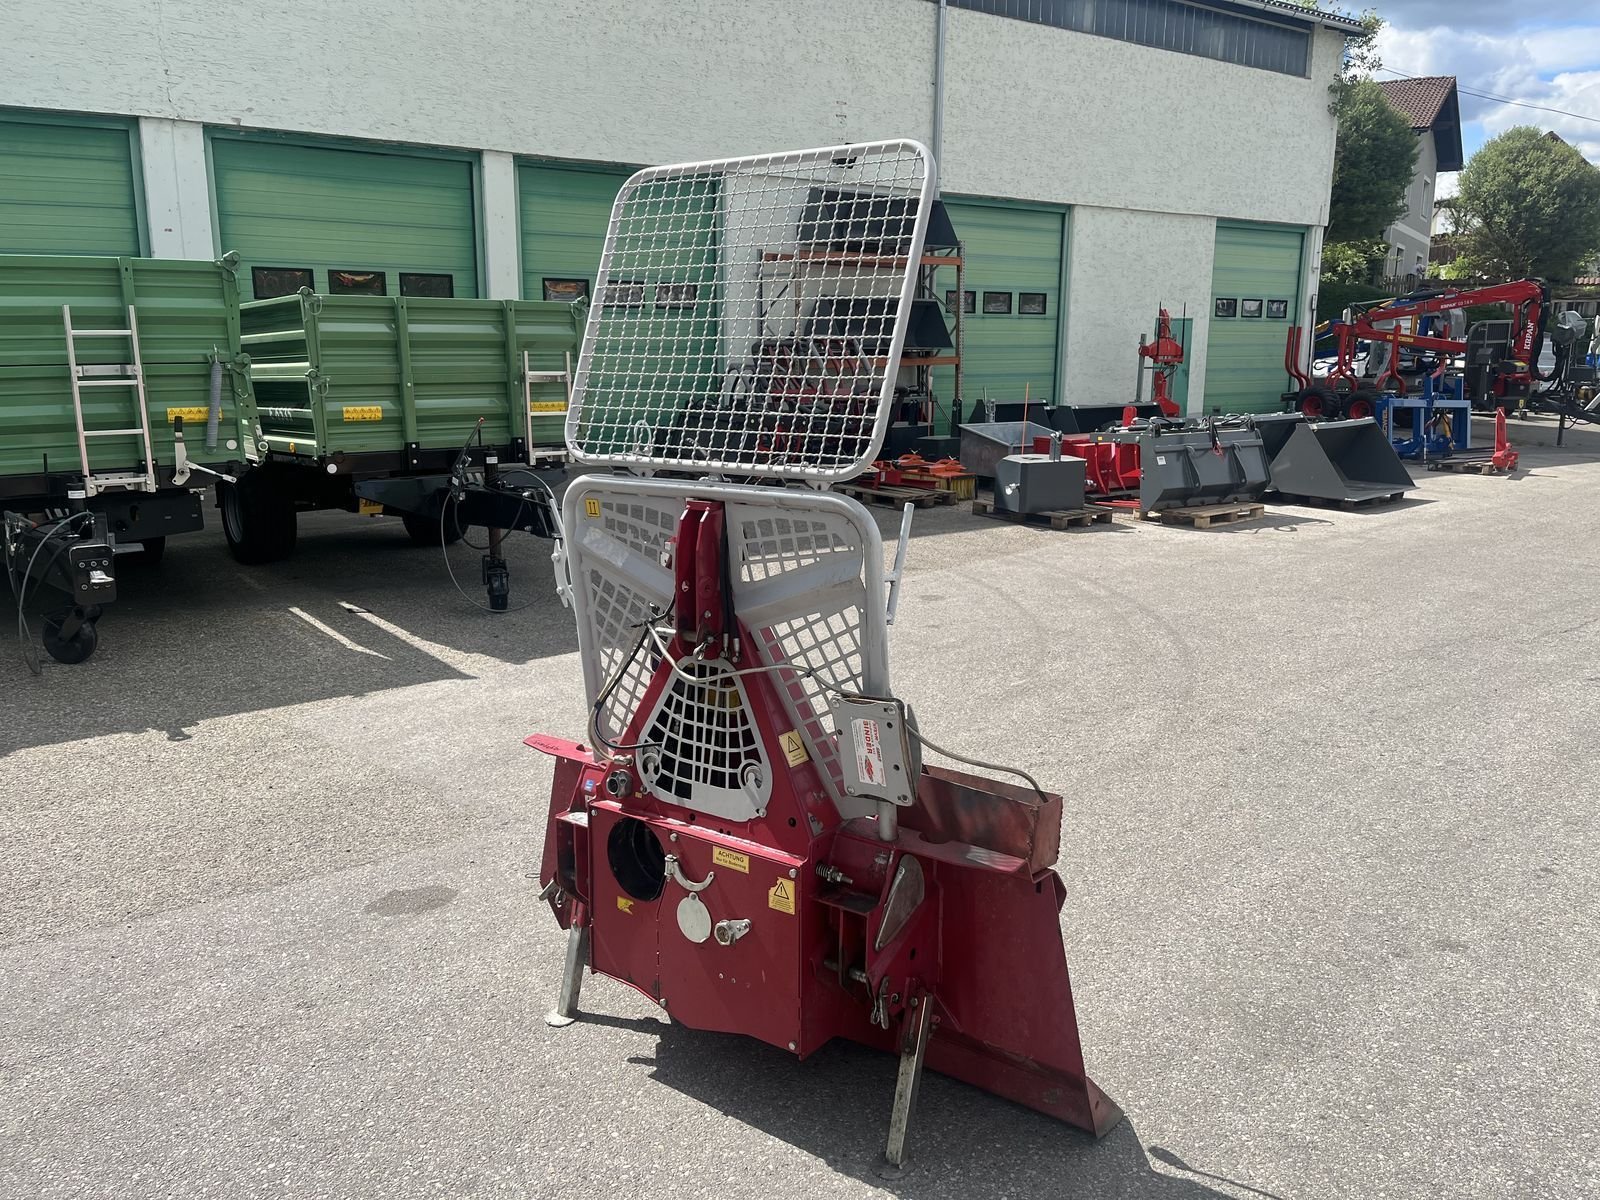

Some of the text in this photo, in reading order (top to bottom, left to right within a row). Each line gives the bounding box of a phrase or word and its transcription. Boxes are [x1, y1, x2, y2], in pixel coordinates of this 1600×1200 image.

[1523, 322, 1535, 350] KRPAN
[863, 720, 873, 754] BINDER
[718, 850, 744, 863] ACHTUNG
